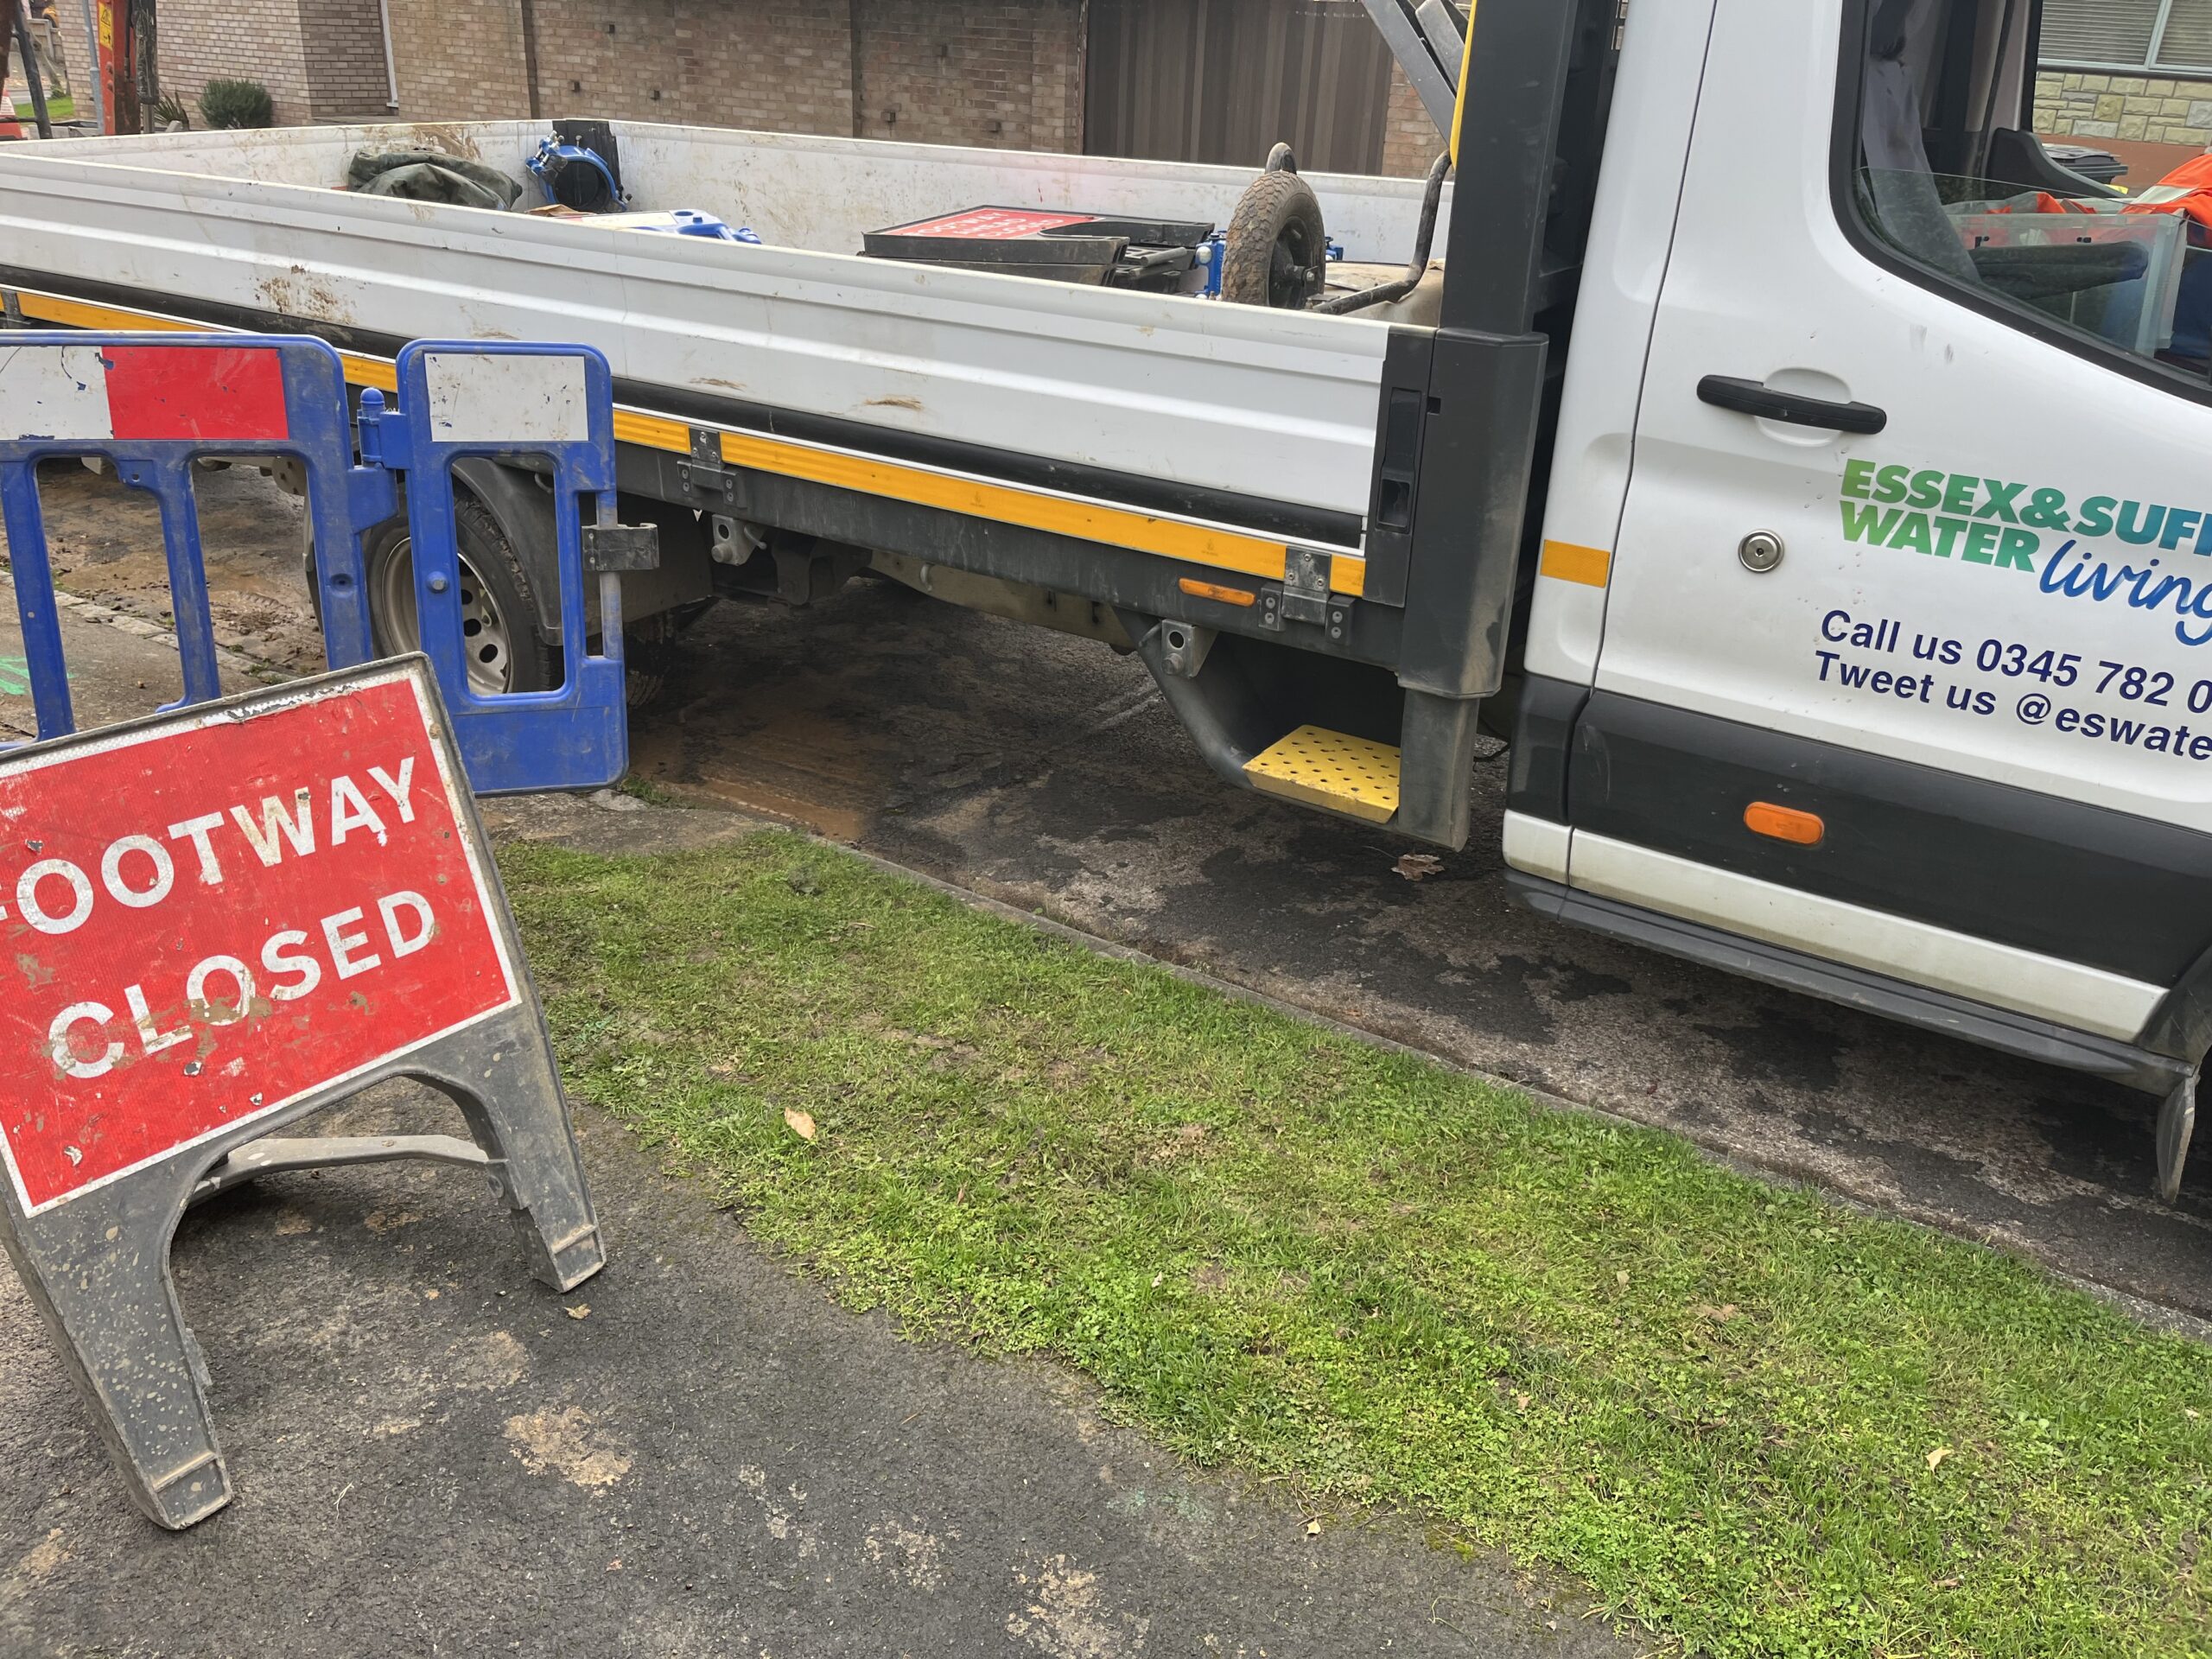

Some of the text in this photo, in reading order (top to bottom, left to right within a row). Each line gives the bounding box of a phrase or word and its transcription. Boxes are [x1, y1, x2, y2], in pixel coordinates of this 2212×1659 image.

[1839, 499, 2040, 573] WATER
[1815, 650, 1934, 704] Tweet
[1946, 684, 1996, 715] us
[1821, 610, 1901, 653] Call
[1912, 633, 1963, 664] us
[1976, 639, 2082, 687] 0345
[2095, 660, 2175, 707] 782
[0, 756, 416, 935] OOTWAY
[48, 890, 434, 1078] CLOSED
